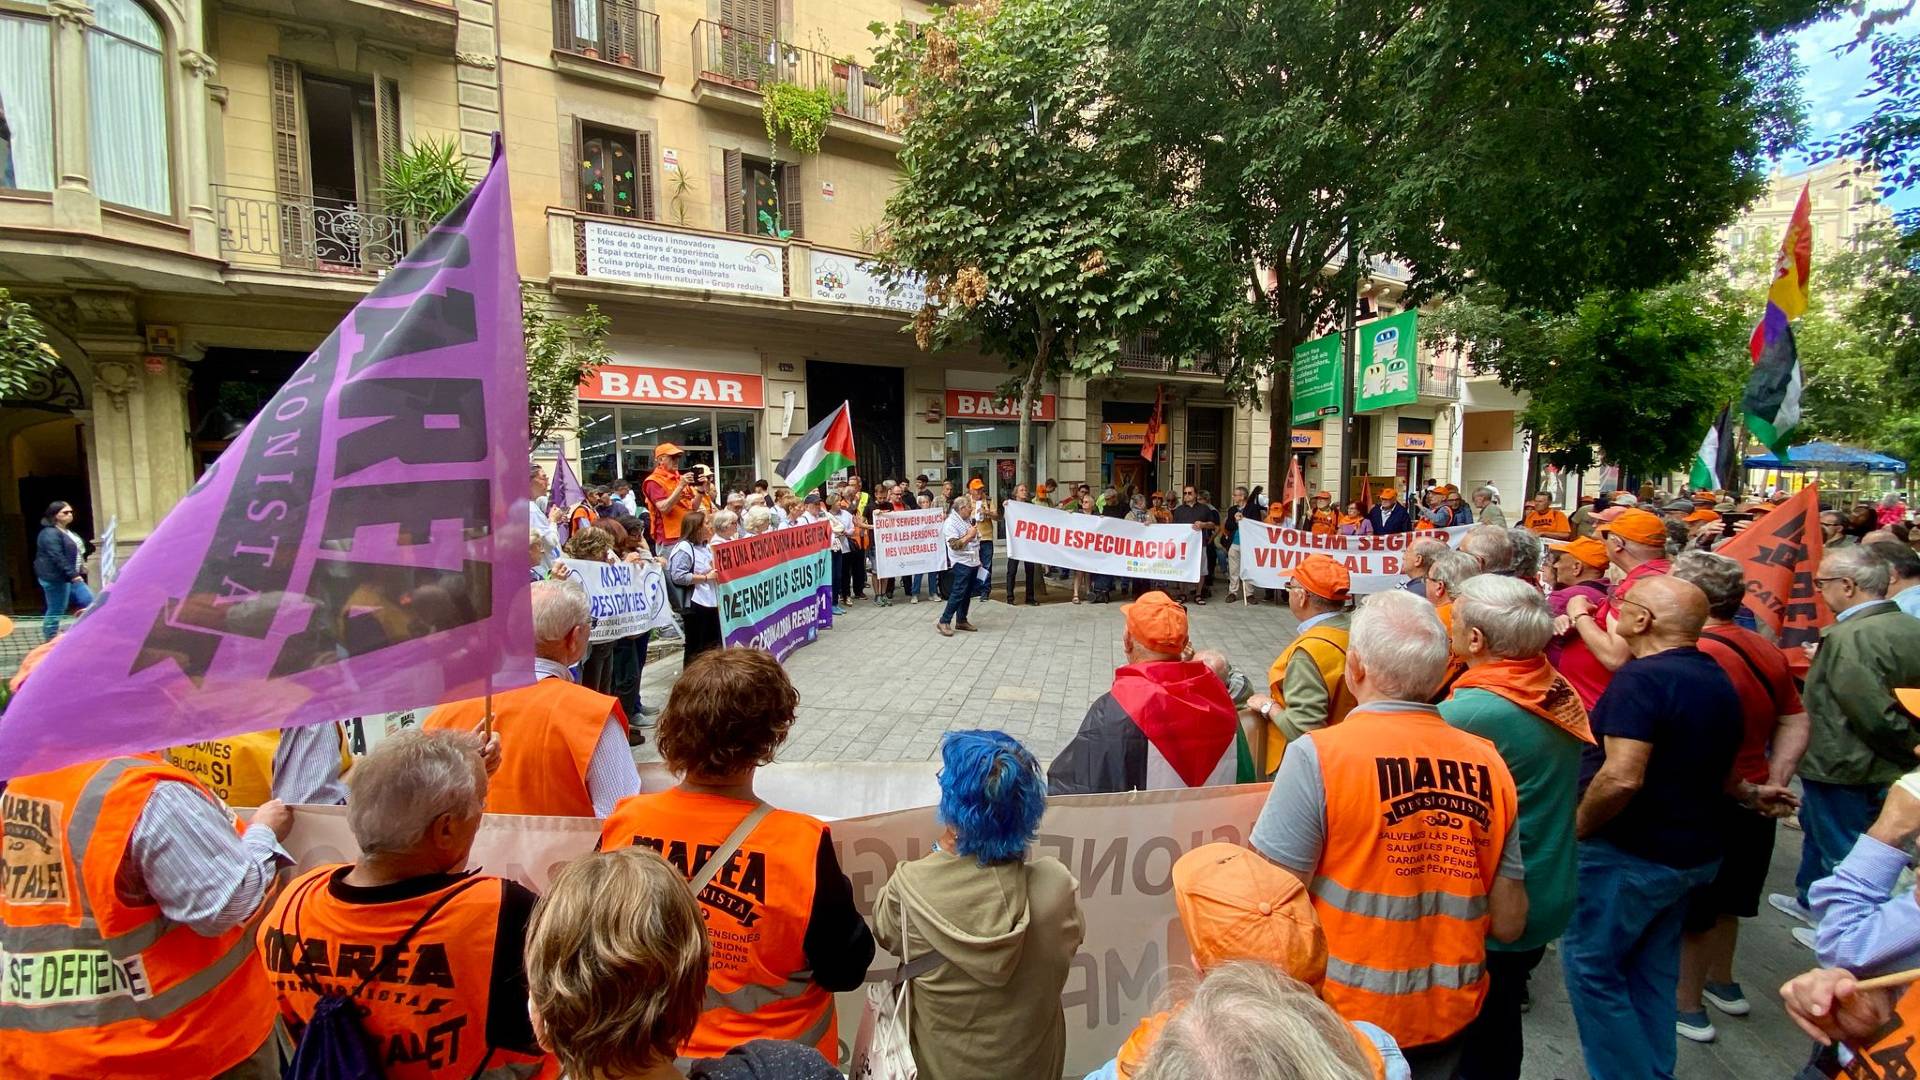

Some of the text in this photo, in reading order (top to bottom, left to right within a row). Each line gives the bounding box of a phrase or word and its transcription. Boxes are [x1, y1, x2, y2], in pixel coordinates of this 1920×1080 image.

[597, 228, 635, 239] Educació
[637, 233, 663, 242] activa
[671, 237, 715, 249] innovadora
[597, 237, 614, 246] Més
[617, 239, 628, 247] de
[630, 241, 641, 249] 40
[643, 243, 663, 253] anys
[597, 247, 621, 257] Espai
[623, 250, 657, 261] exterior
[659, 254, 670, 262] de
[699, 259, 717, 268] amb
[719, 261, 736, 270] Hort
[598, 257, 623, 266] Cuina
[657, 264, 685, 274] menús
[687, 268, 730, 279] equilibrats
[598, 266, 632, 277] Classes
[634, 271, 653, 279] amb
[654, 272, 672, 282] llum
[674, 275, 704, 285] natural
[712, 279, 735, 289] Grups
[868, 296, 881, 306] 93
[600, 371, 744, 403] BASAR
[896, 515, 920, 527] SERVEIS
[881, 533, 893, 543] PER
[899, 531, 910, 542] LES
[910, 528, 939, 540] PERSONES
[1014, 519, 1061, 545] PROU
[1064, 529, 1176, 560] ESPECULACIÓ
[1267, 527, 1347, 550] VOLEM
[897, 542, 938, 556] VULNERABLES
[1343, 556, 1373, 575] AL
[776, 575, 789, 599] ELS
[791, 565, 813, 593] SEUS
[211, 761, 233, 787] SI
[1375, 757, 1495, 813] MAREA
[1398, 795, 1486, 820] PENSIONISTA
[1378, 830, 1426, 841] SALVEMOS
[1428, 831, 1449, 841] LAS
[1423, 842, 1443, 852] LES
[1427, 854, 1441, 863] AS
[707, 927, 761, 944] ENSIONES
[10, 957, 35, 999] SE
